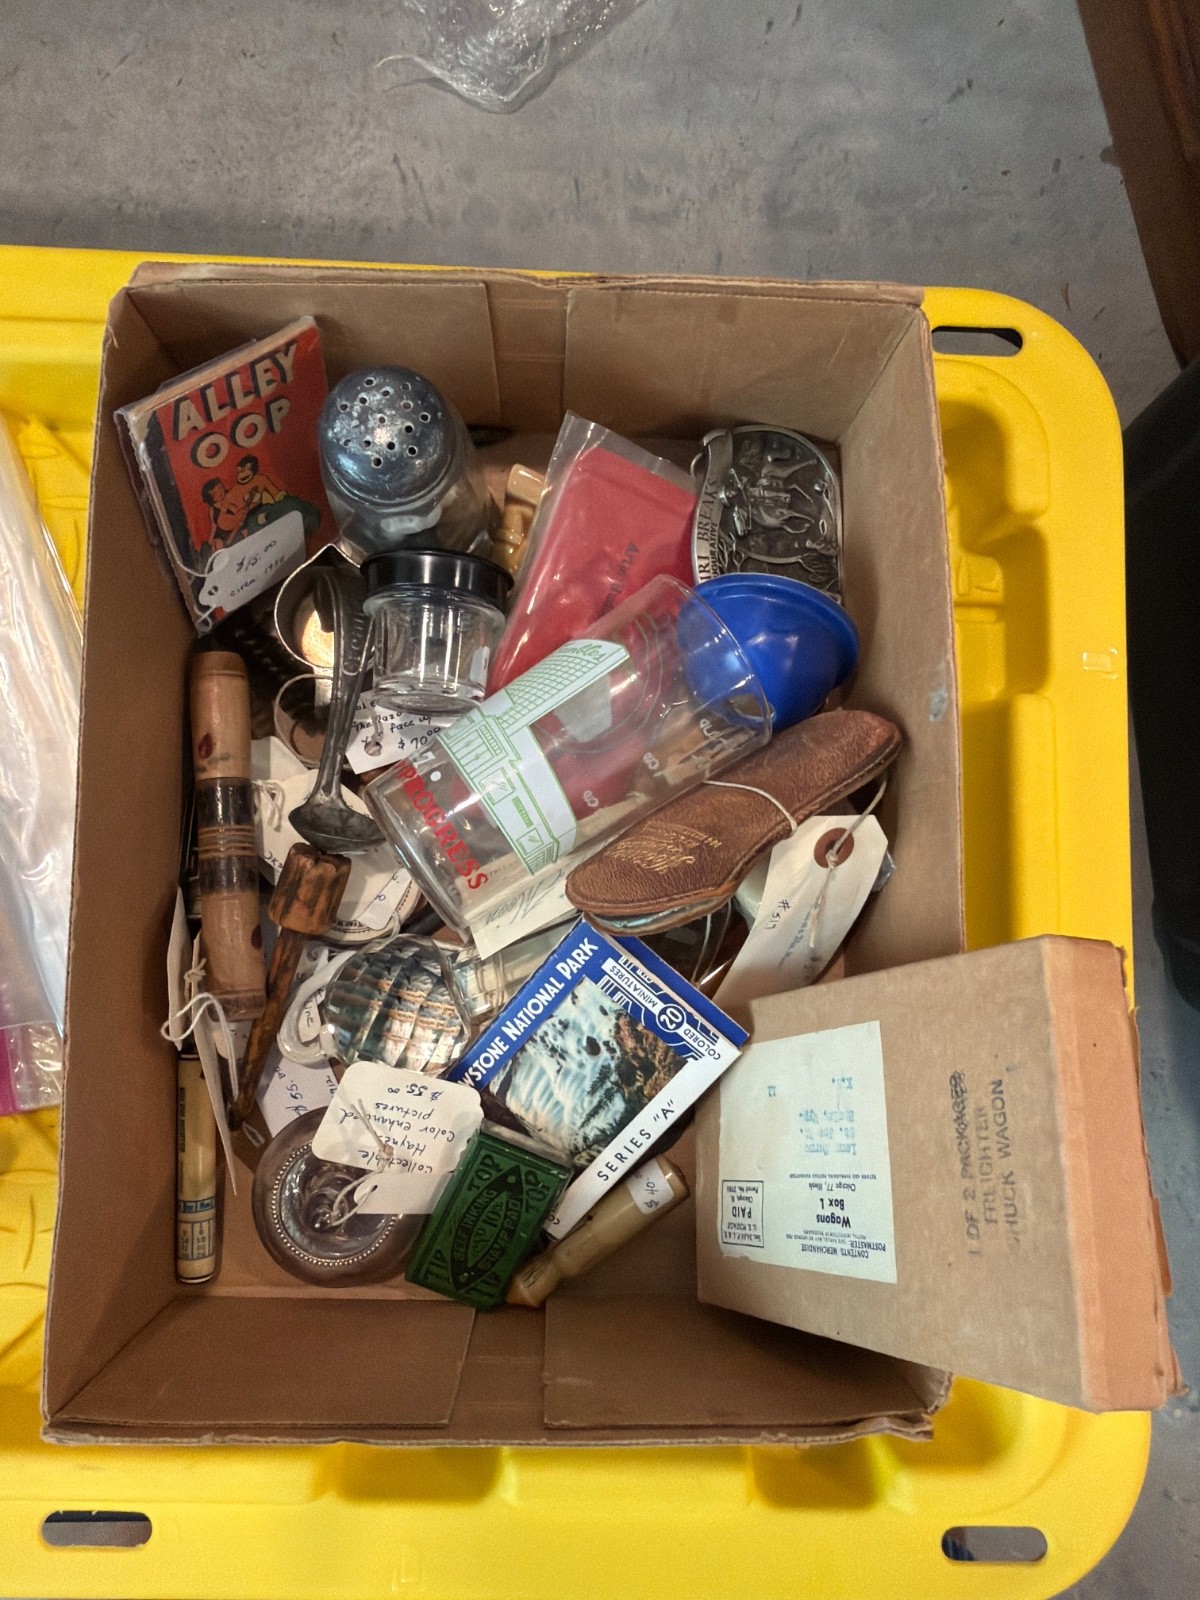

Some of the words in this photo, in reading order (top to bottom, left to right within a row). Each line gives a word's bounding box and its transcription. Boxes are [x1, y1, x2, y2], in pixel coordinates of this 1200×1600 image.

[172, 340, 298, 441] ALLEY
[190, 398, 290, 469] OOP
[698, 479, 718, 542] BREAKS
[397, 758, 487, 889] PROGRESS
[501, 976, 565, 1041] NATIONAL
[556, 937, 599, 981] PARK
[608, 965, 658, 1009] MINIATURES
[660, 1007, 683, 1031] 20
[683, 1027, 721, 1061] COLORED
[375, 1102, 435, 1119] pictures
[992, 1079, 1011, 1160] WAGON
[419, 1127, 455, 1142] Color
[597, 1128, 652, 1182] SERIES
[467, 1153, 503, 1192] TOP
[836, 1182, 856, 1192] Chicago
[525, 1169, 551, 1213] TOP
[828, 1198, 845, 1210] Box
[963, 1188, 976, 1201] 2
[504, 1200, 519, 1229] PAD
[732, 1206, 752, 1219] PAID
[816, 1212, 851, 1228] Wagons
[965, 1208, 980, 1240] OF
[801, 1243, 838, 1255] MERCHANDISE
